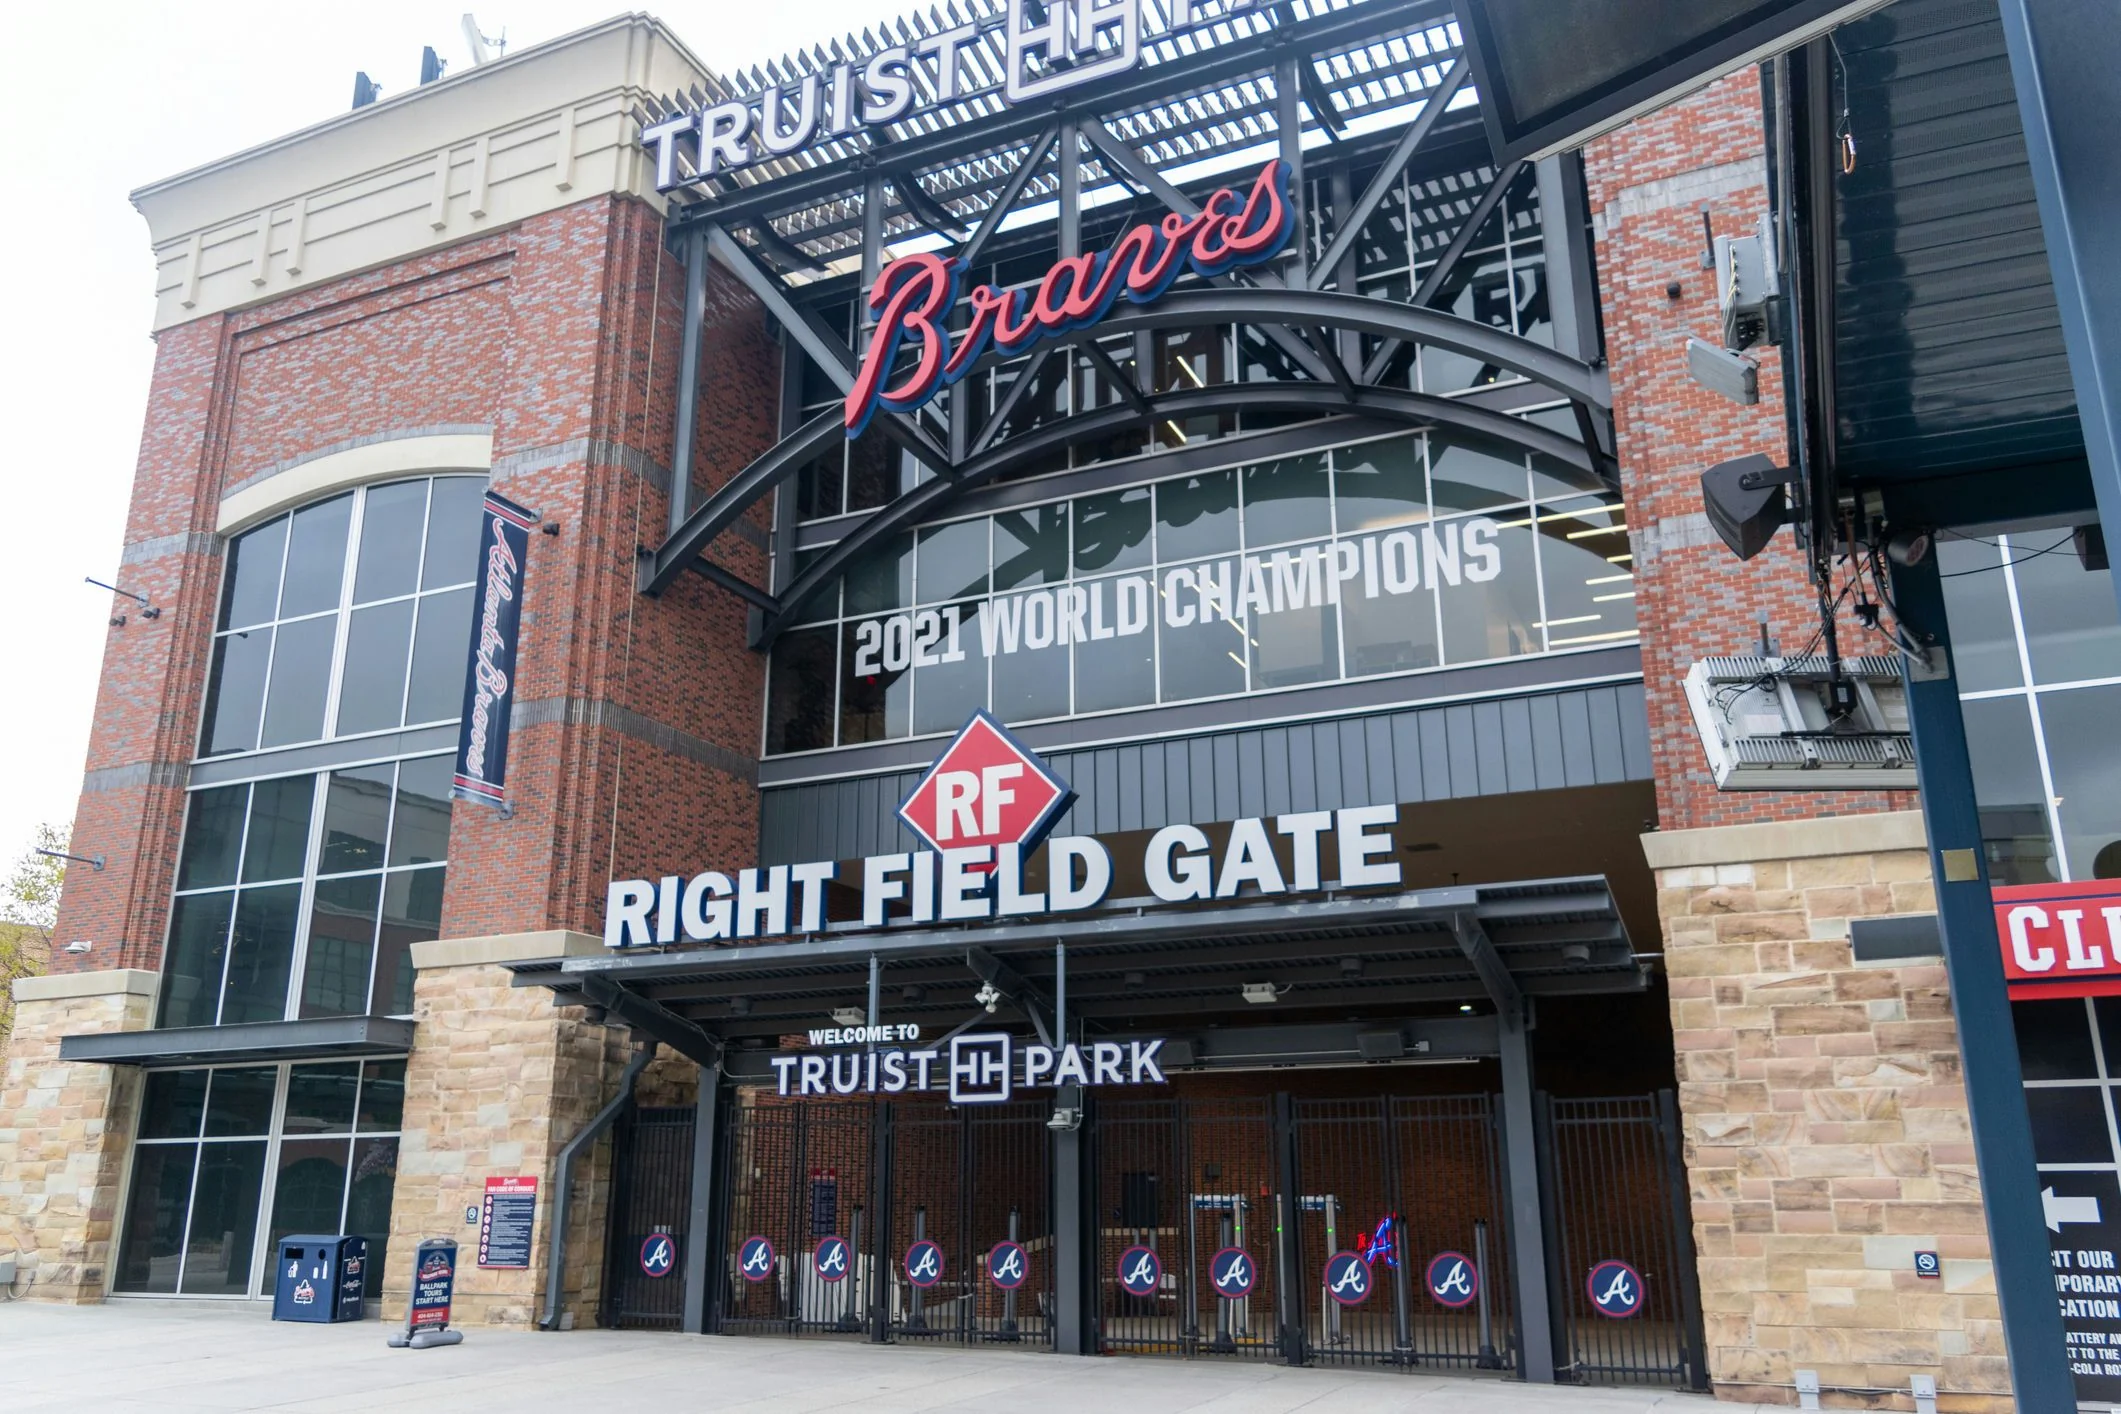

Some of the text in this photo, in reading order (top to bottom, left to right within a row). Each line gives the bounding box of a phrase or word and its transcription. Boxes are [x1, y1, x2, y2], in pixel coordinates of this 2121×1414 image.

[642, 21, 979, 194] TRUIST
[845, 159, 1293, 438] Braves
[855, 518, 1501, 677] 2021 WORLD CHAMPIONS
[466, 518, 517, 778] Atlanta Braves
[935, 762, 1025, 841] RF
[604, 804, 1402, 948] RIGHT FIELD GATE
[809, 1023, 920, 1046] WELCOME TO
[771, 1038, 1168, 1096] TRUIST PARK
[643, 1238, 669, 1268] A
[742, 1241, 769, 1271] A
[818, 1241, 845, 1272] A
[909, 1246, 938, 1277] A
[992, 1247, 1022, 1279] A
[1124, 1252, 1155, 1285] A
[2051, 1250, 2115, 1269] IT OUR
[420, 1282, 448, 1291] BALLPARK
[1216, 1253, 1249, 1287] A
[1330, 1258, 1365, 1294] A
[1434, 1259, 1470, 1296] A
[1596, 1268, 1635, 1305] A
[424, 1289, 443, 1297] TOURS
[2066, 1332, 2106, 1344] ATTERY
[2079, 1348, 2096, 1360] TO
[2097, 1348, 2120, 1360] THE
